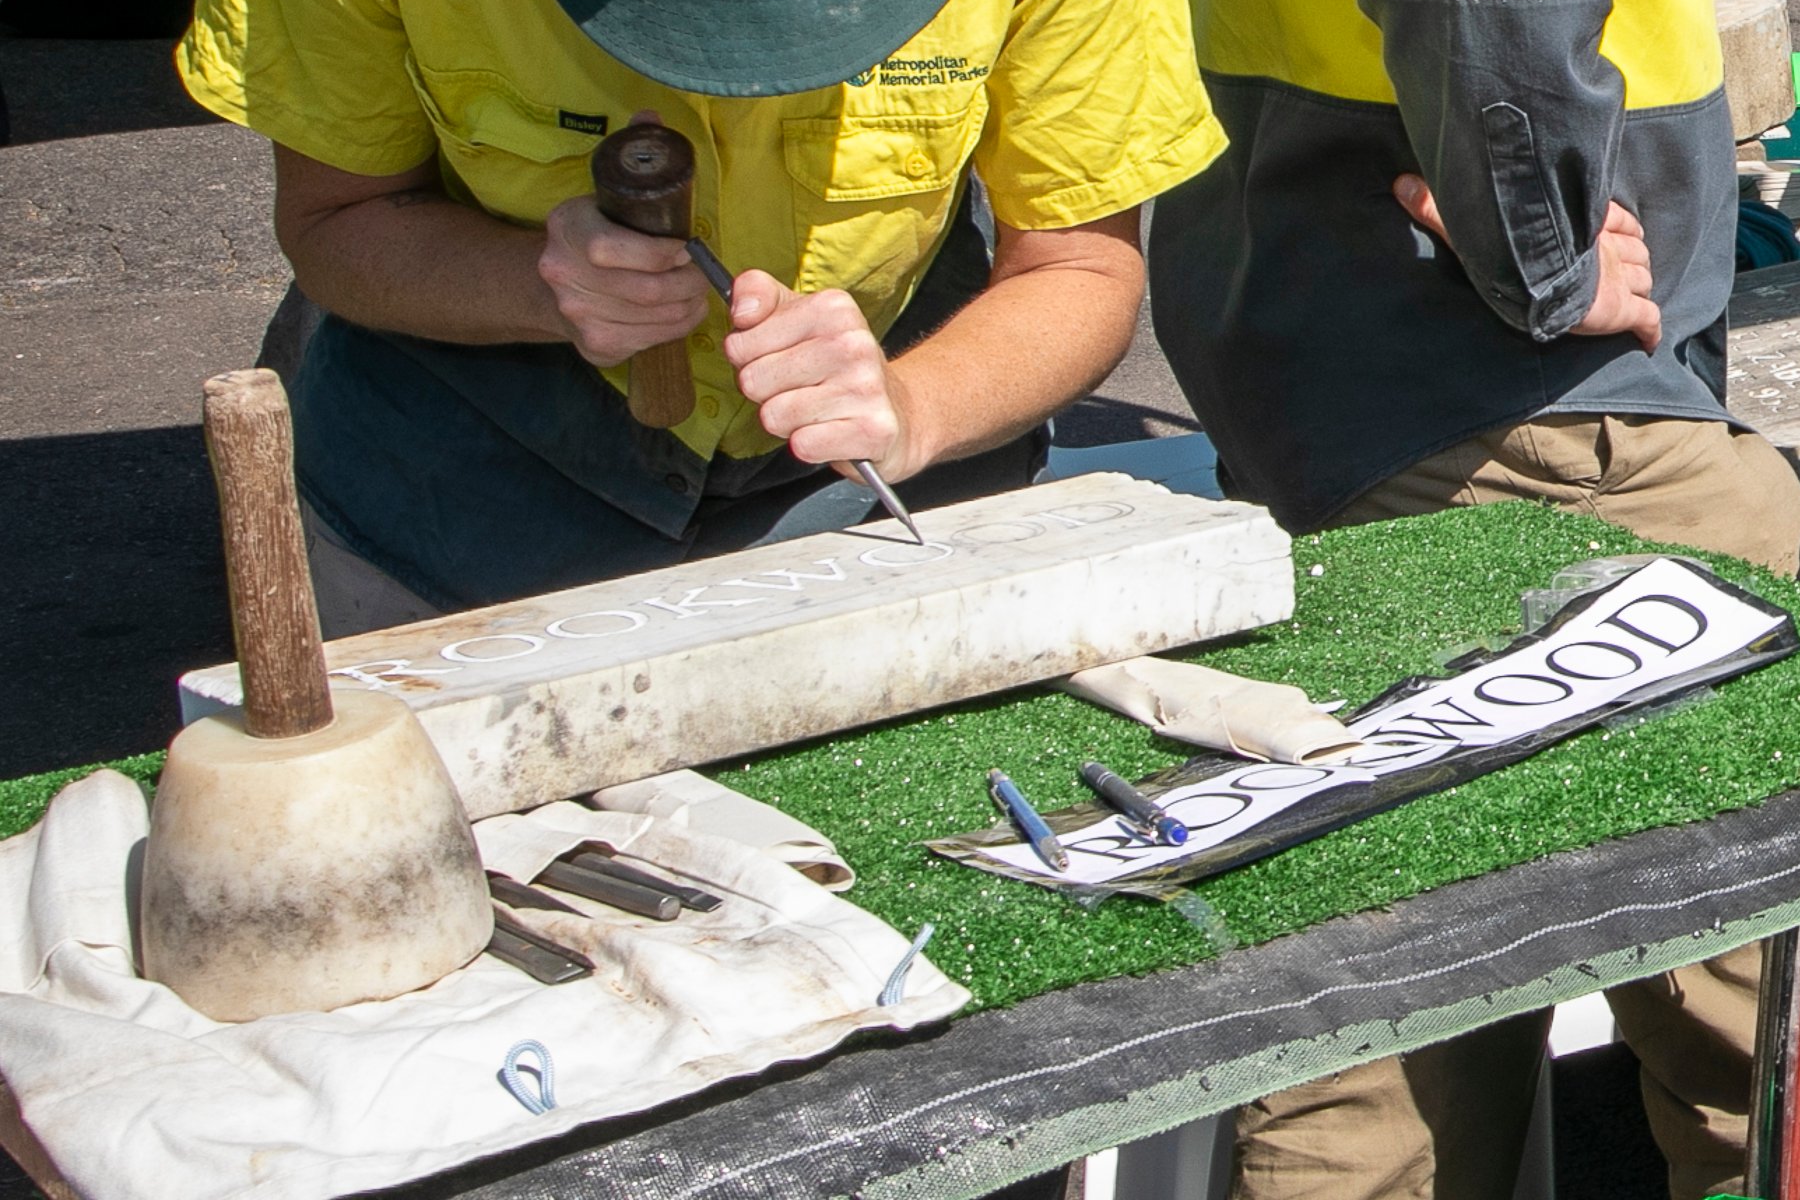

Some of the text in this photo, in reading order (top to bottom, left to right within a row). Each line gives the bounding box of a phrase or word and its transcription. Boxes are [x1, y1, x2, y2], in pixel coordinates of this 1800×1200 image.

[879, 65, 989, 86] Memorial Parks
[328, 501, 1135, 690] ROOKWOOD
[1062, 593, 1709, 866] ROOWOOD
